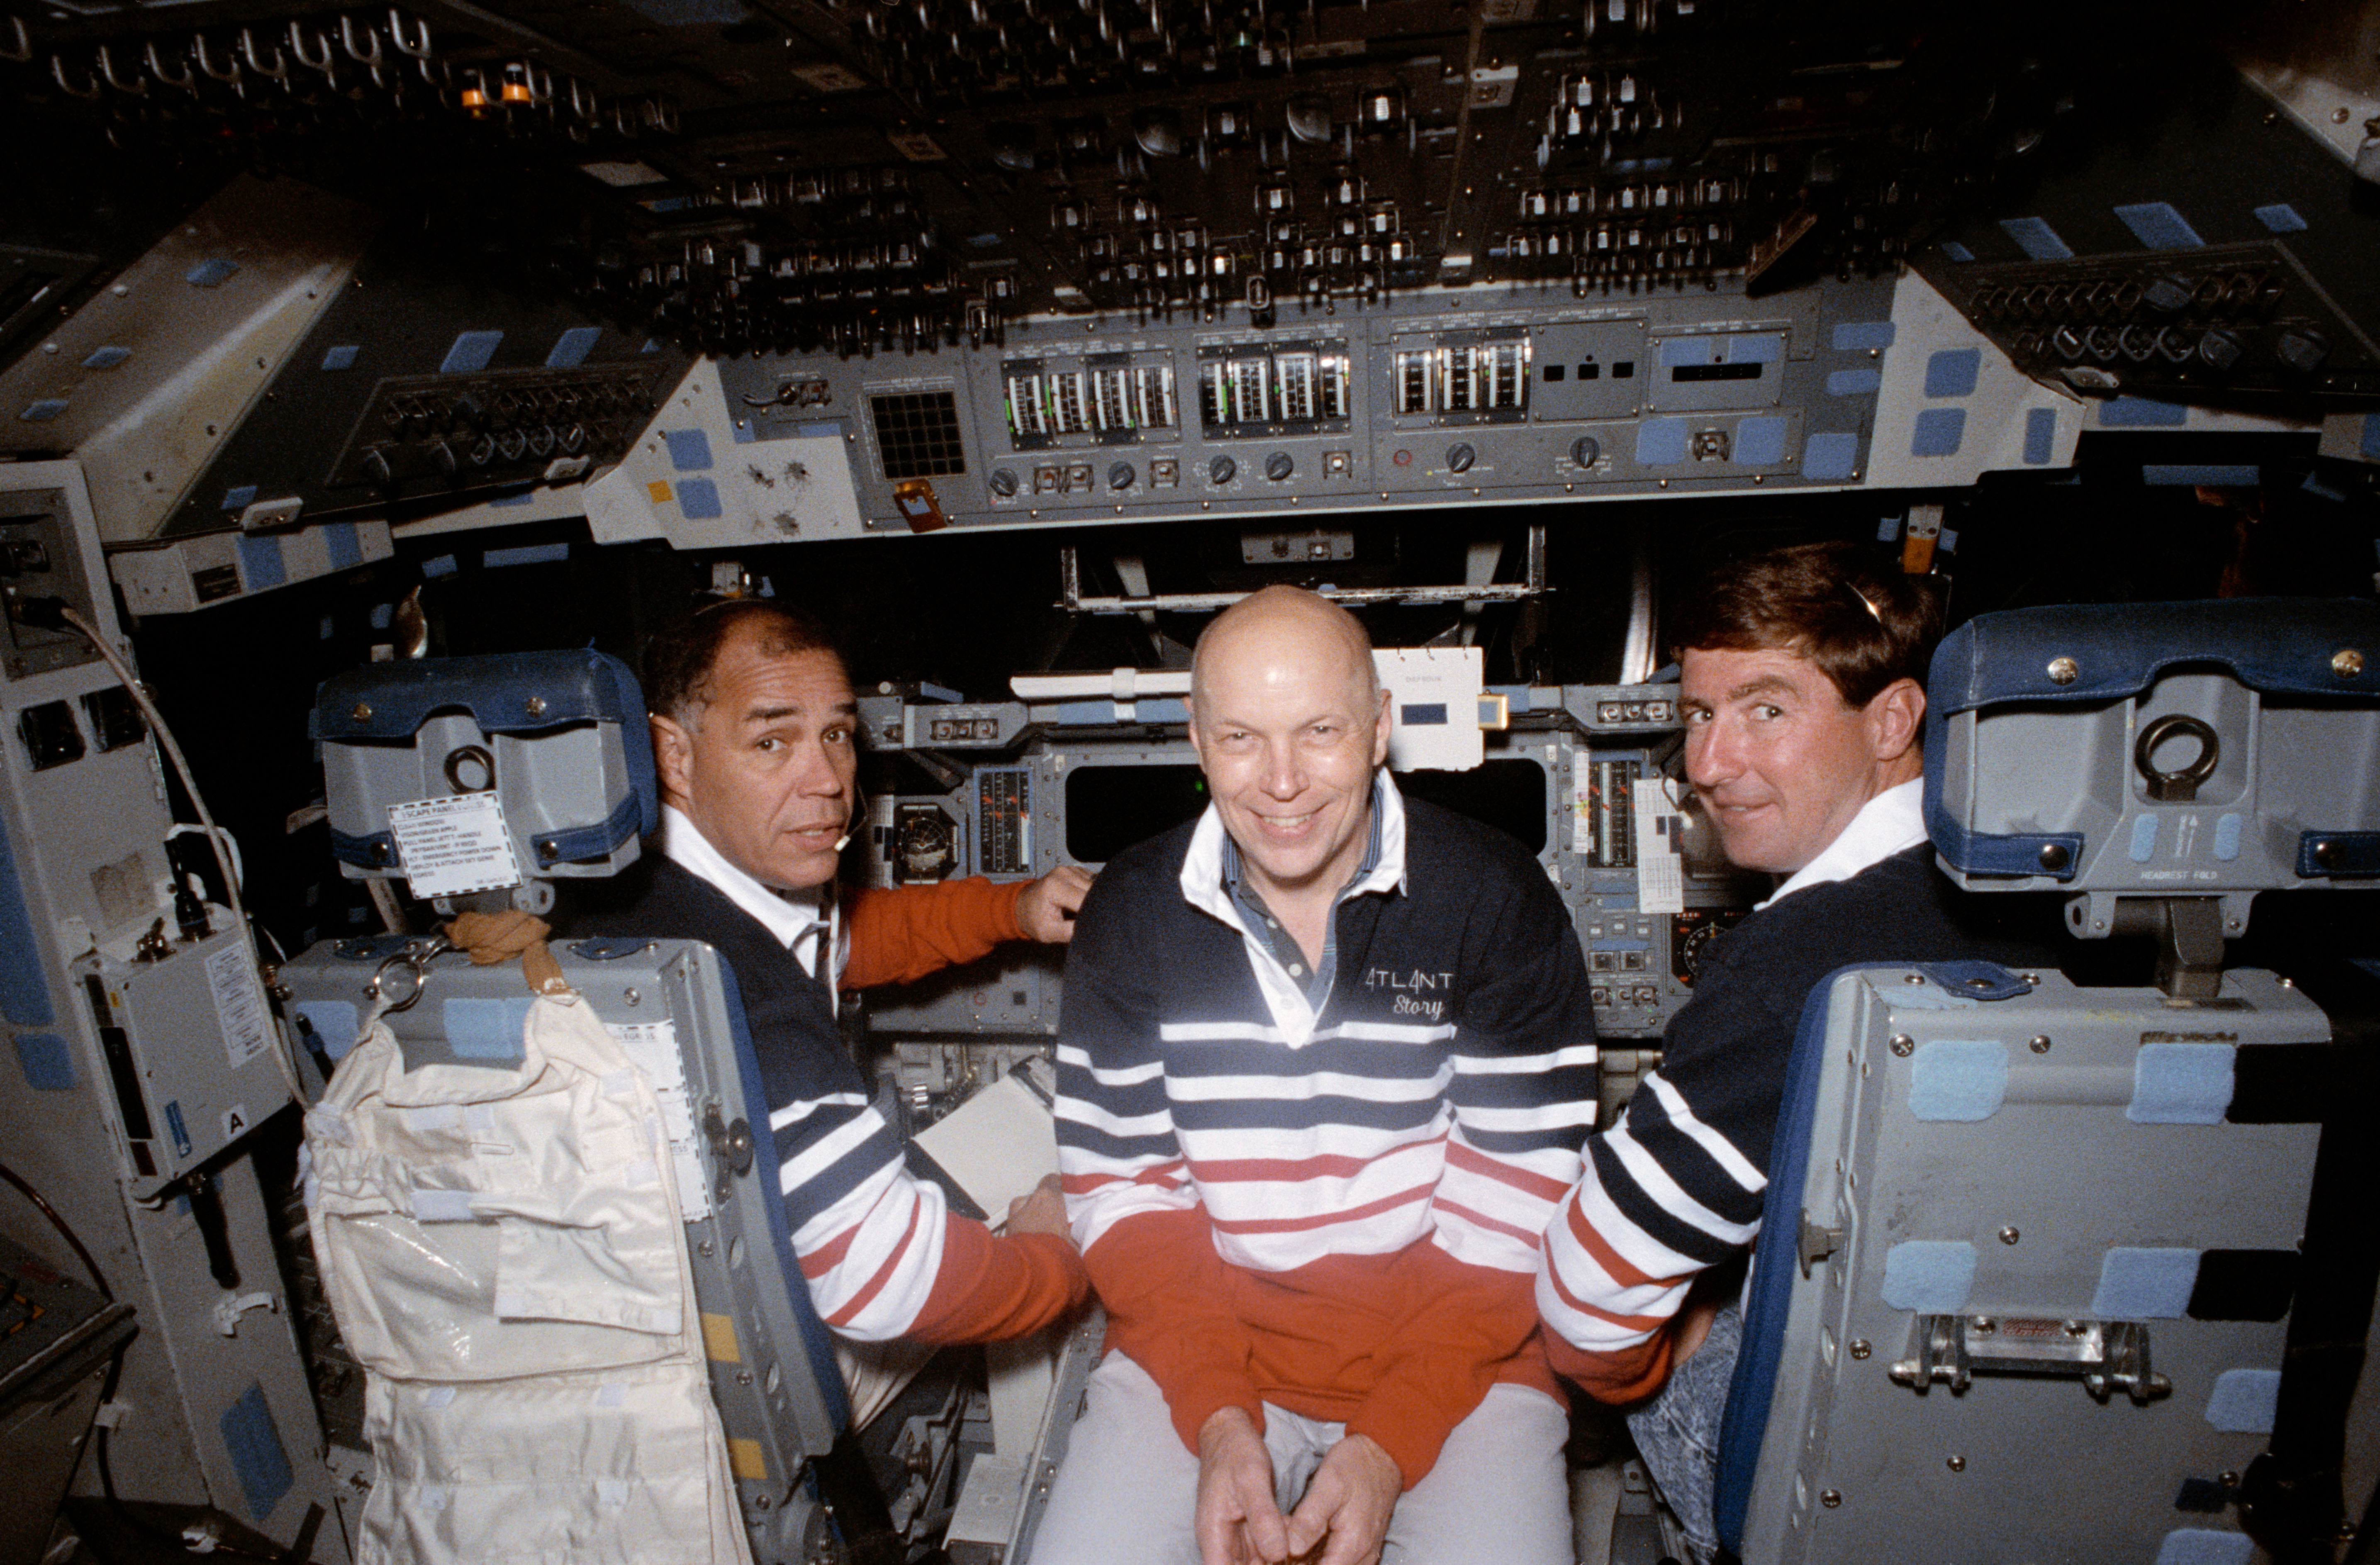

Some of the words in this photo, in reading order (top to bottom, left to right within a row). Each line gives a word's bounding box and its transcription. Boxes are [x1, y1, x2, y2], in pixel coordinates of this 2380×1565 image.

[402, 809, 431, 819] ESCAPE
[431, 804, 455, 814] PANEL
[2141, 870, 2188, 880] HEADREST
[2193, 870, 2217, 880] FOLD
[1393, 994, 1443, 1021] Story
[231, 1113, 244, 1134] A
